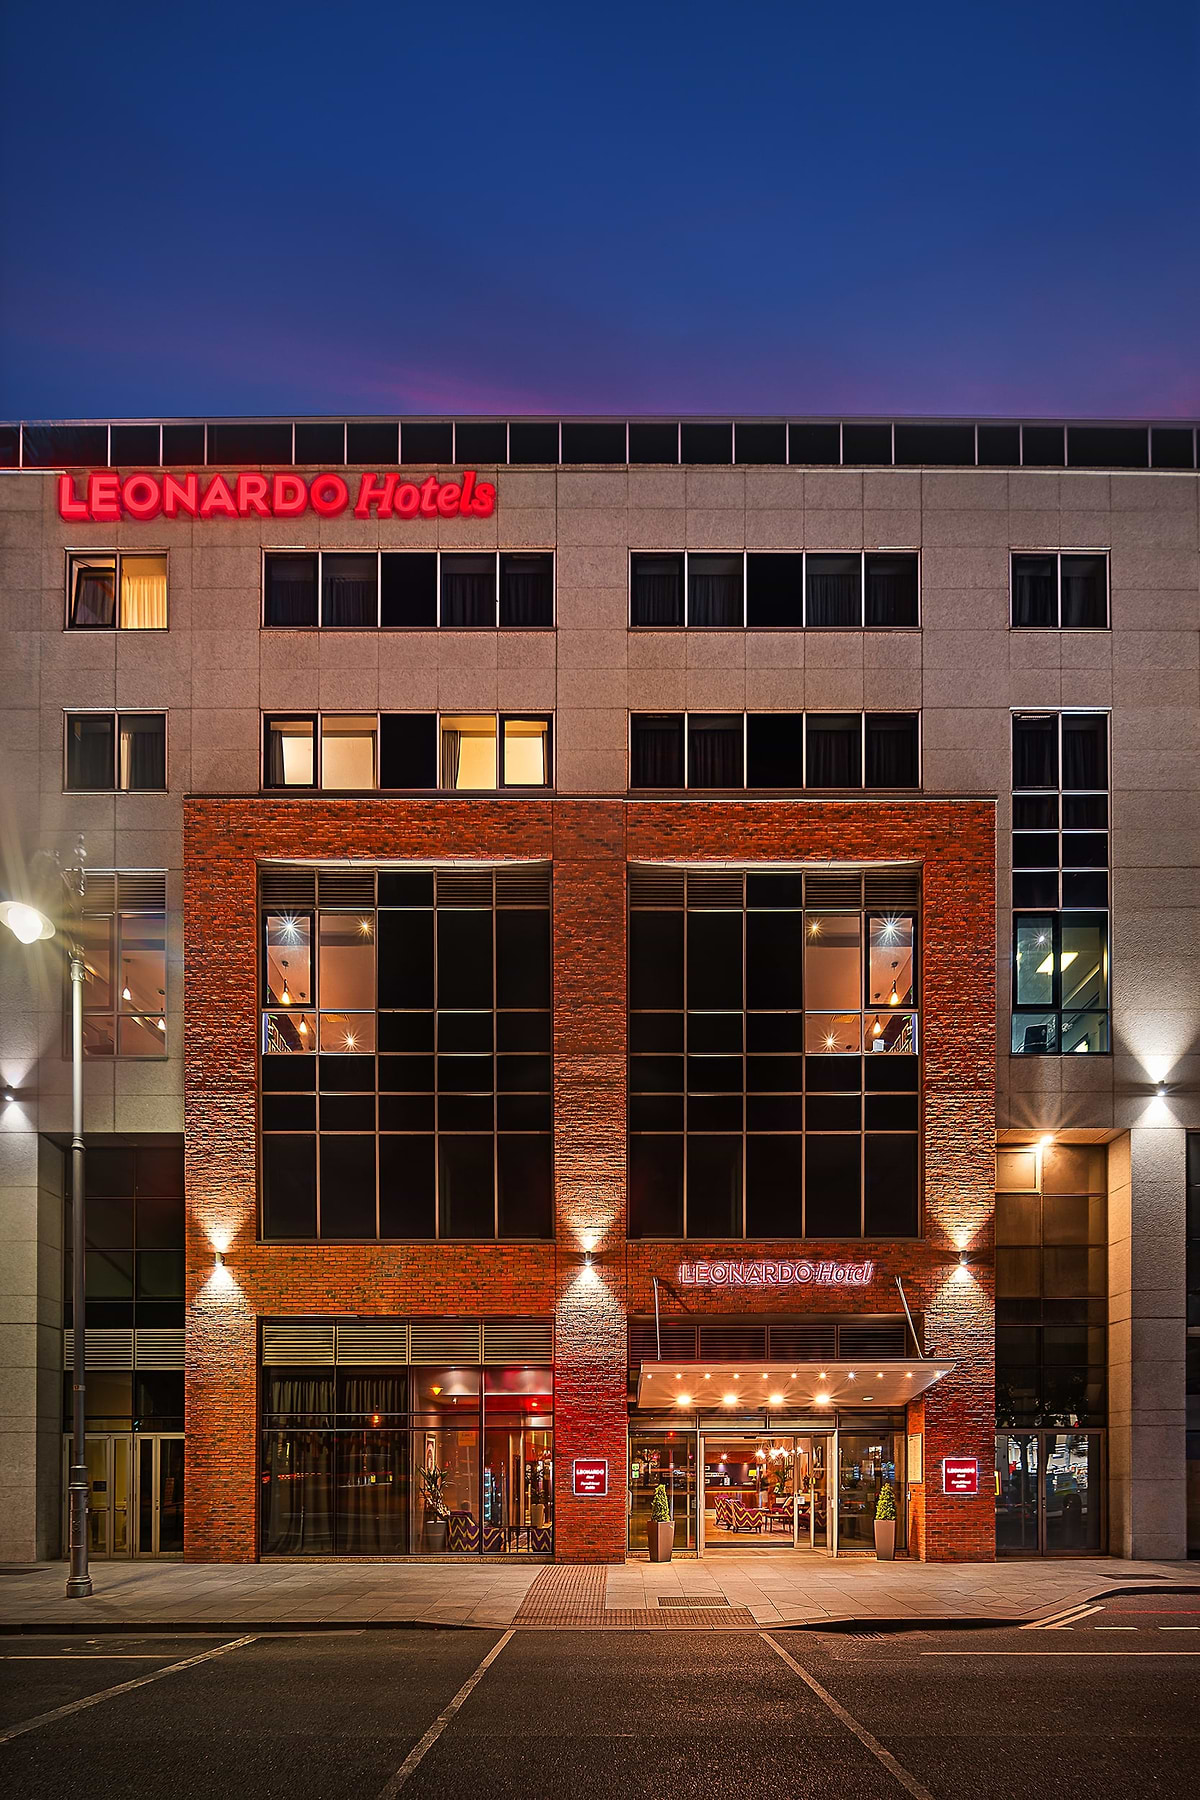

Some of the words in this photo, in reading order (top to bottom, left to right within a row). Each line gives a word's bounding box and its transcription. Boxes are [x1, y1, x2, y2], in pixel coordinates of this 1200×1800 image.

[59, 473, 349, 520] LEONARDO
[353, 470, 496, 518] Hotels
[681, 1262, 813, 1284] LEONARDO
[816, 1261, 872, 1284] Hotel
